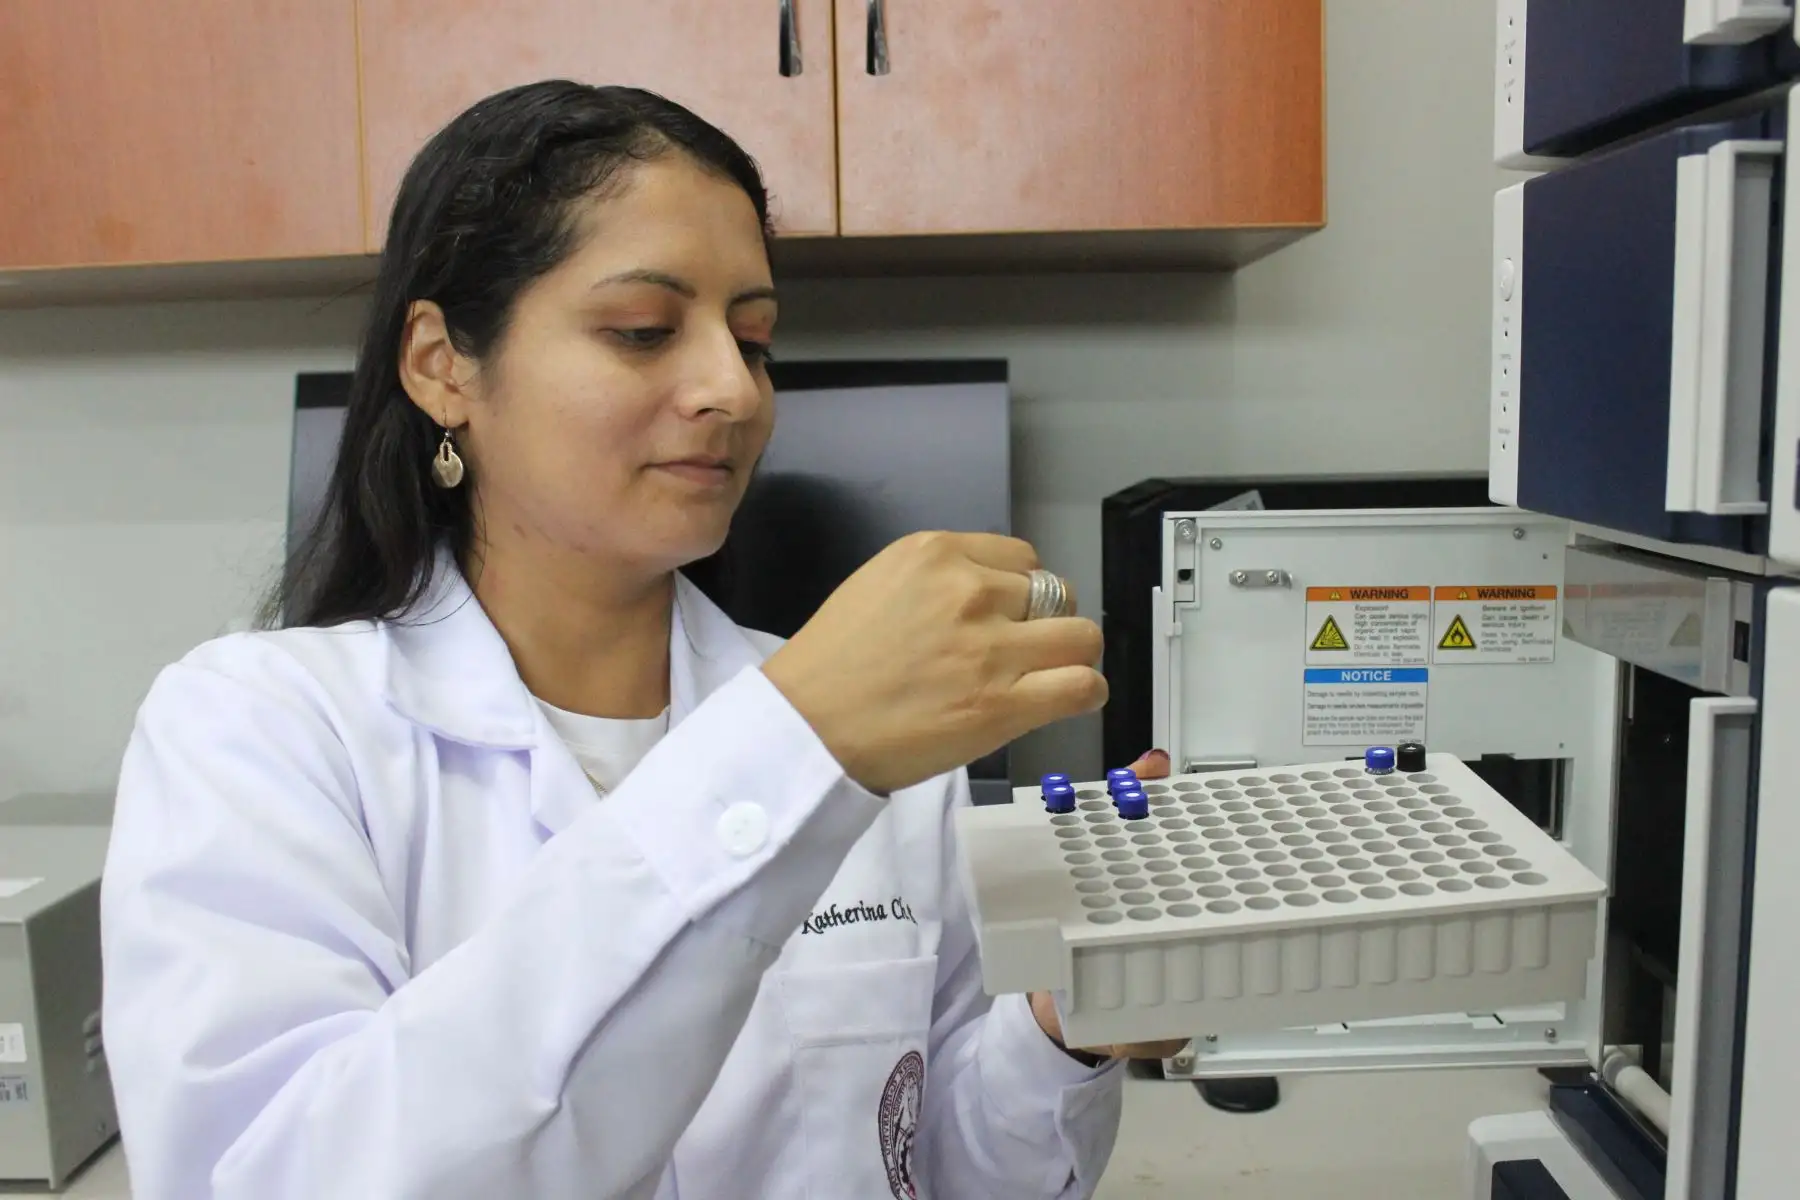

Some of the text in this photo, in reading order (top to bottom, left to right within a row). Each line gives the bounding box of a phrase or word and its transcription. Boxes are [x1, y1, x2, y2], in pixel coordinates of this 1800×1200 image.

[1350, 589, 1409, 599] WARNING
[1477, 588, 1536, 598] WARNING
[1341, 670, 1392, 682] NOTICE
